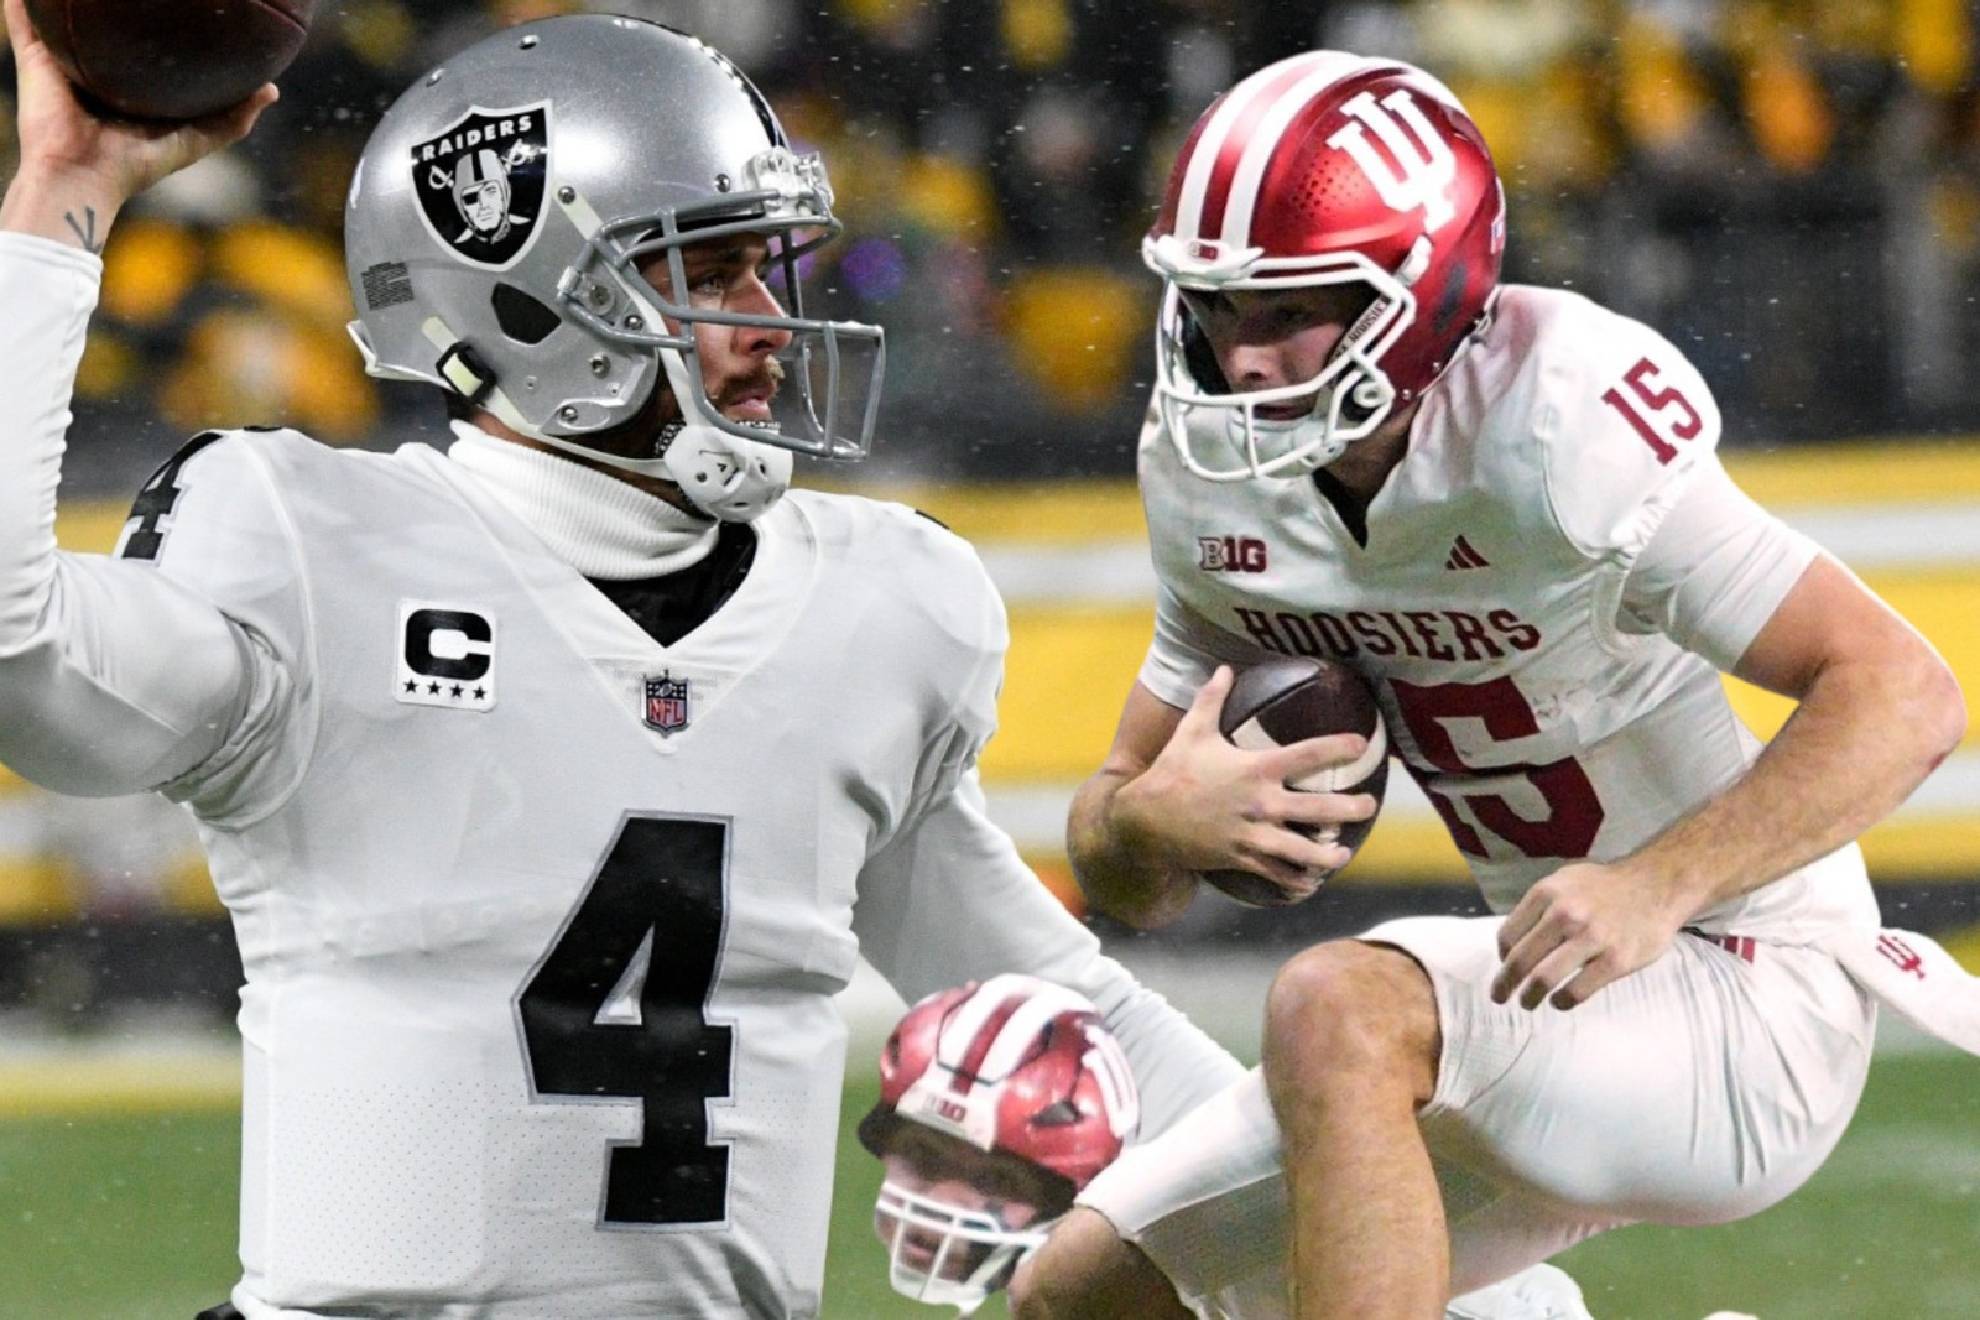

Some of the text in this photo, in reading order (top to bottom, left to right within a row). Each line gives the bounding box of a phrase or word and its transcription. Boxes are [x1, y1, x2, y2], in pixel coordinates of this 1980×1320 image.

[422, 115, 533, 161] RAIDERS
[1601, 357, 1703, 466] 15
[121, 431, 223, 561] 4
[405, 609, 491, 681] C
[1234, 608, 1541, 661] HOOSIERS
[649, 698, 684, 725] NFL
[511, 808, 738, 1233] 4
